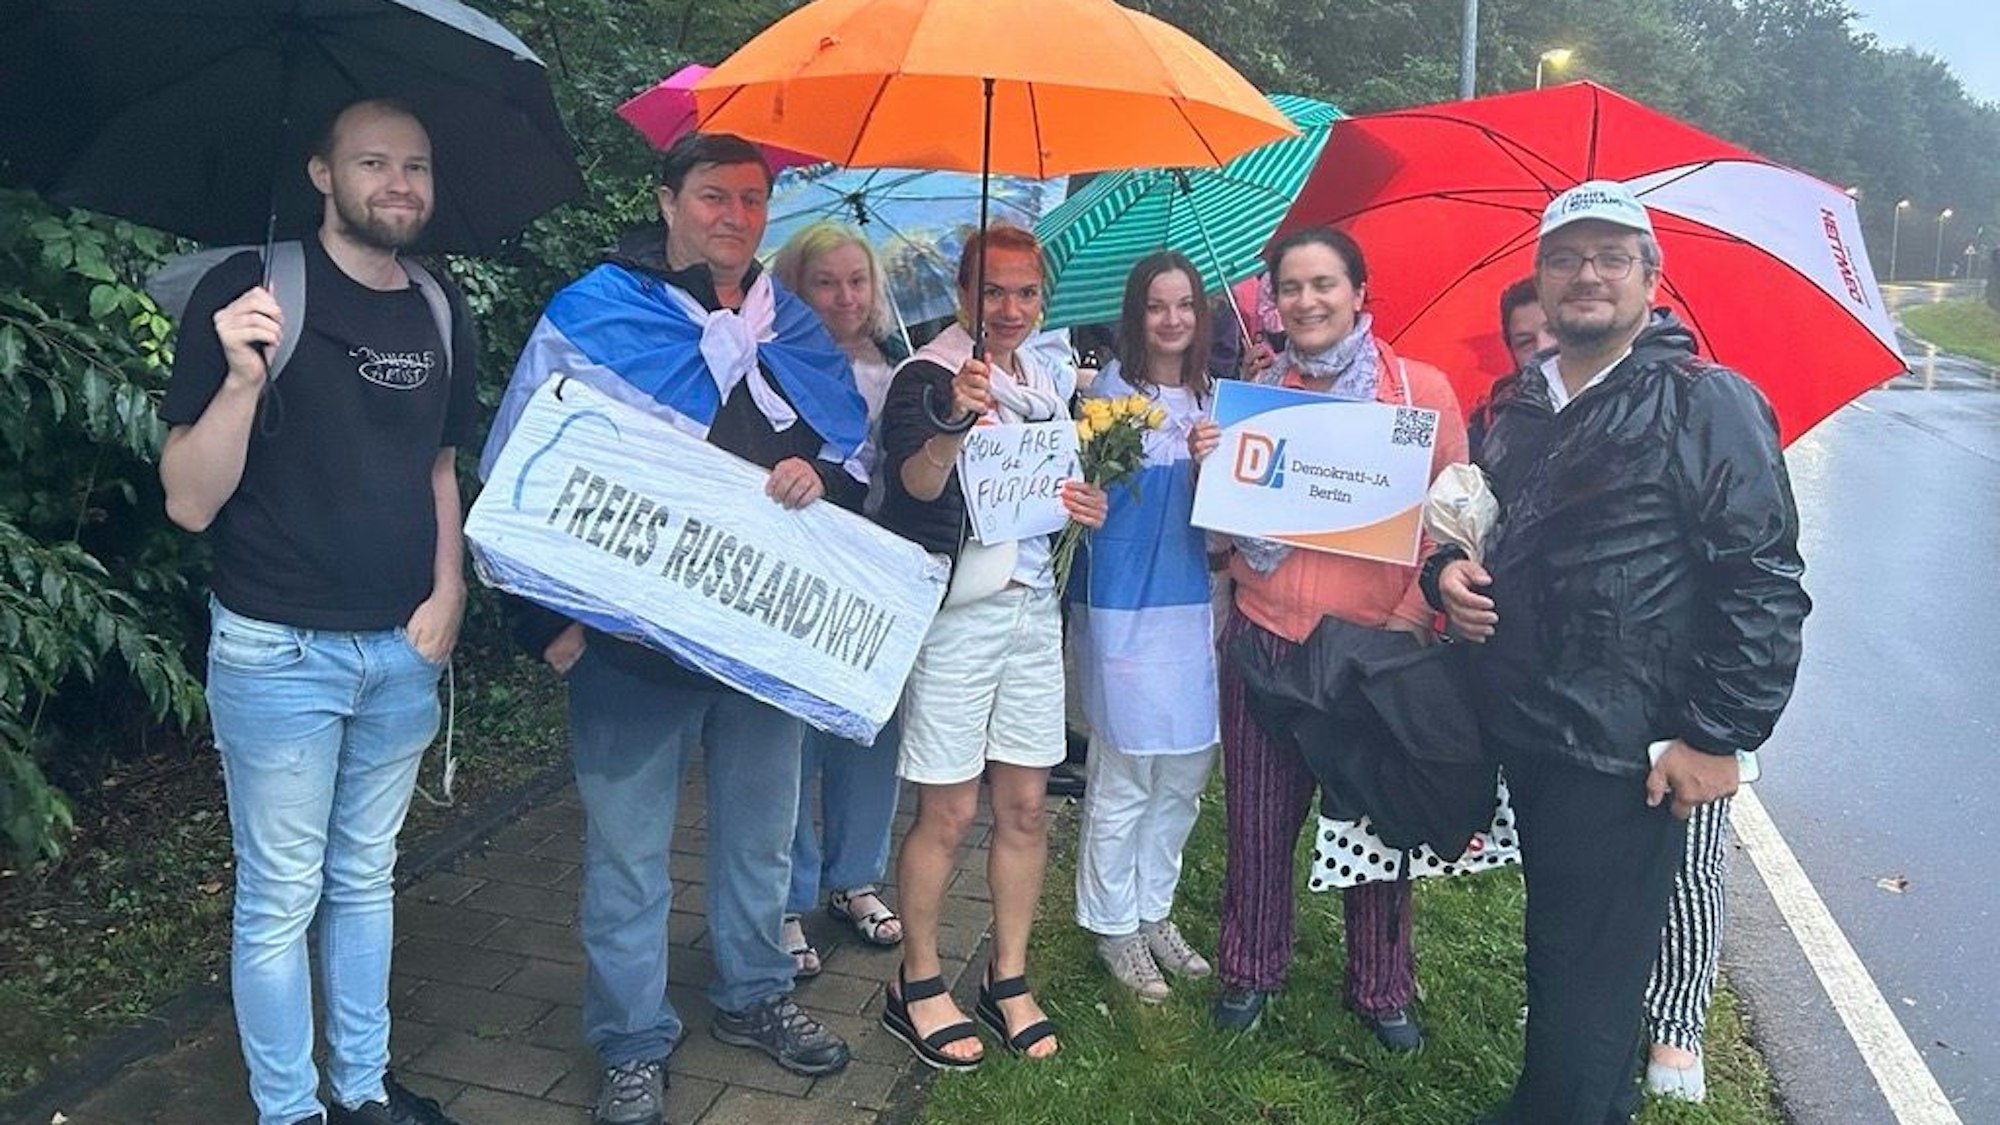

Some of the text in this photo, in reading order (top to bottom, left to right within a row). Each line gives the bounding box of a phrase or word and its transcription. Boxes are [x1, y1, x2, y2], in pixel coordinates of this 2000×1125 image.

[1020, 429, 1062, 455] ARE
[1308, 485, 1352, 503] Berlin
[547, 466, 669, 566] FREIES
